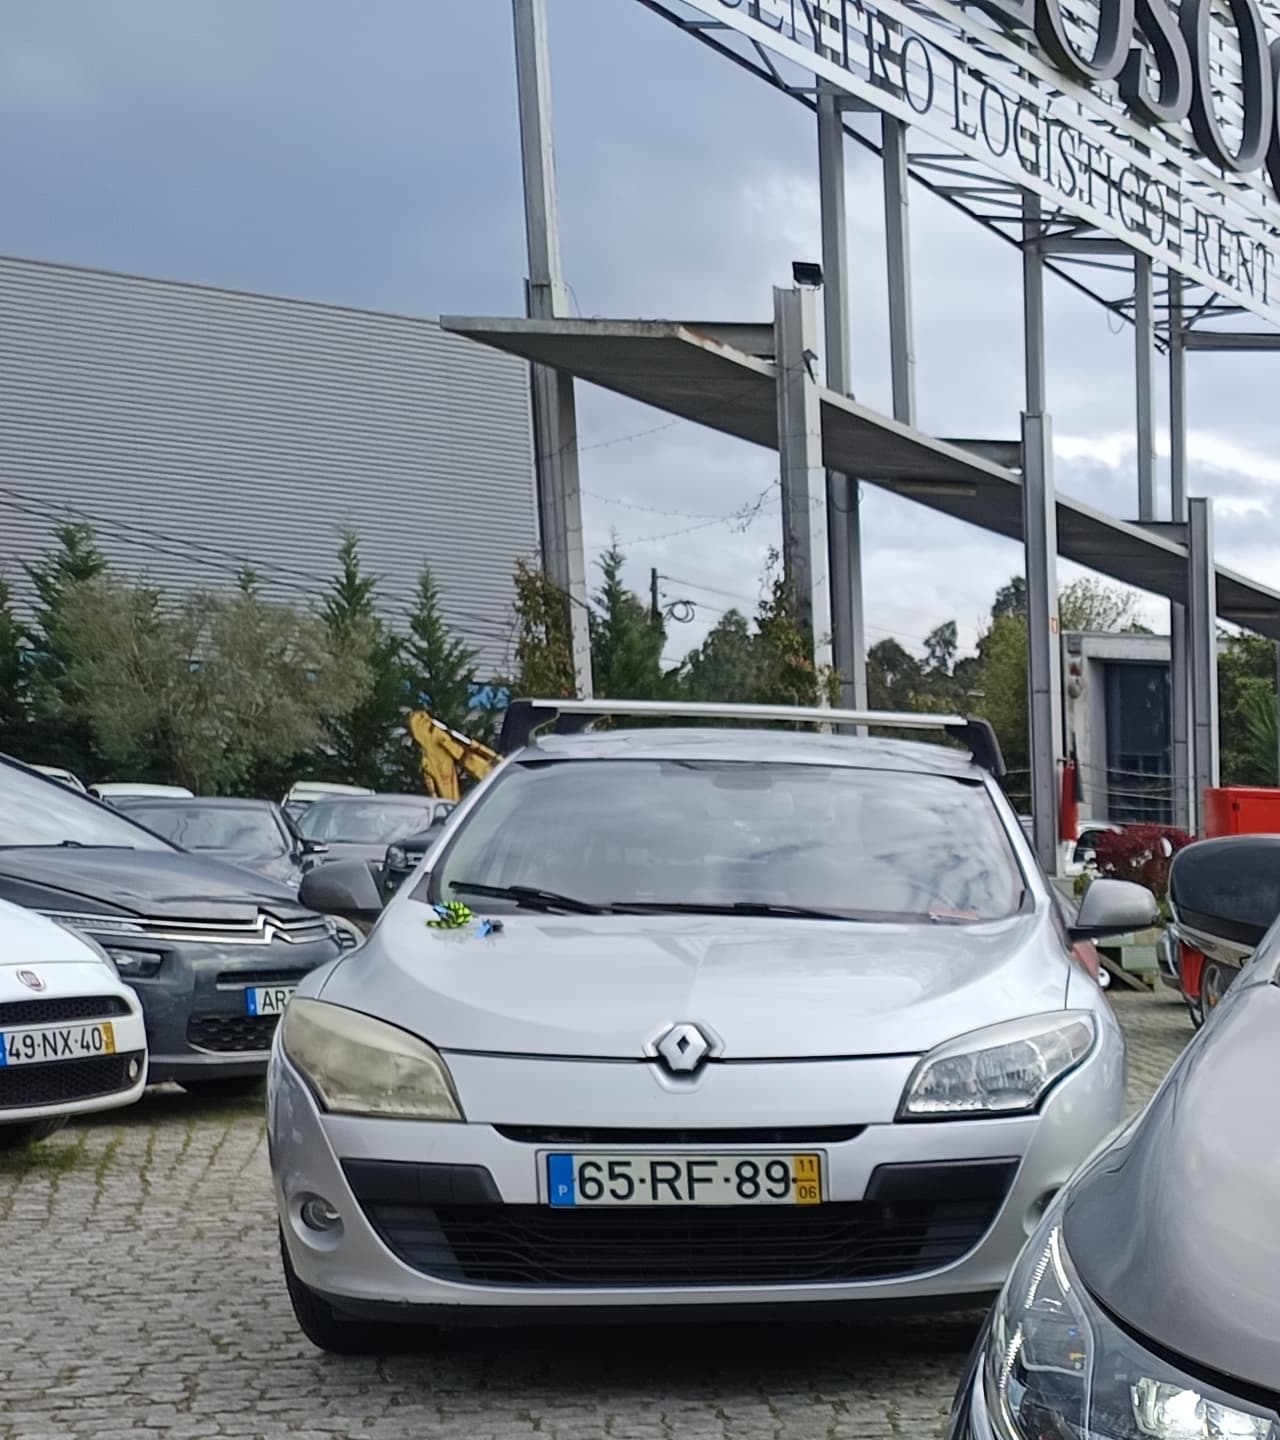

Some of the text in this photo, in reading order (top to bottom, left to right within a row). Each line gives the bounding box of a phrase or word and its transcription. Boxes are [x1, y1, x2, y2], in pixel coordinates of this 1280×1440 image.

[1193, 206, 1275, 305] RENT
[262, 989, 296, 1012] AR
[799, 1185, 817, 1200] 06
